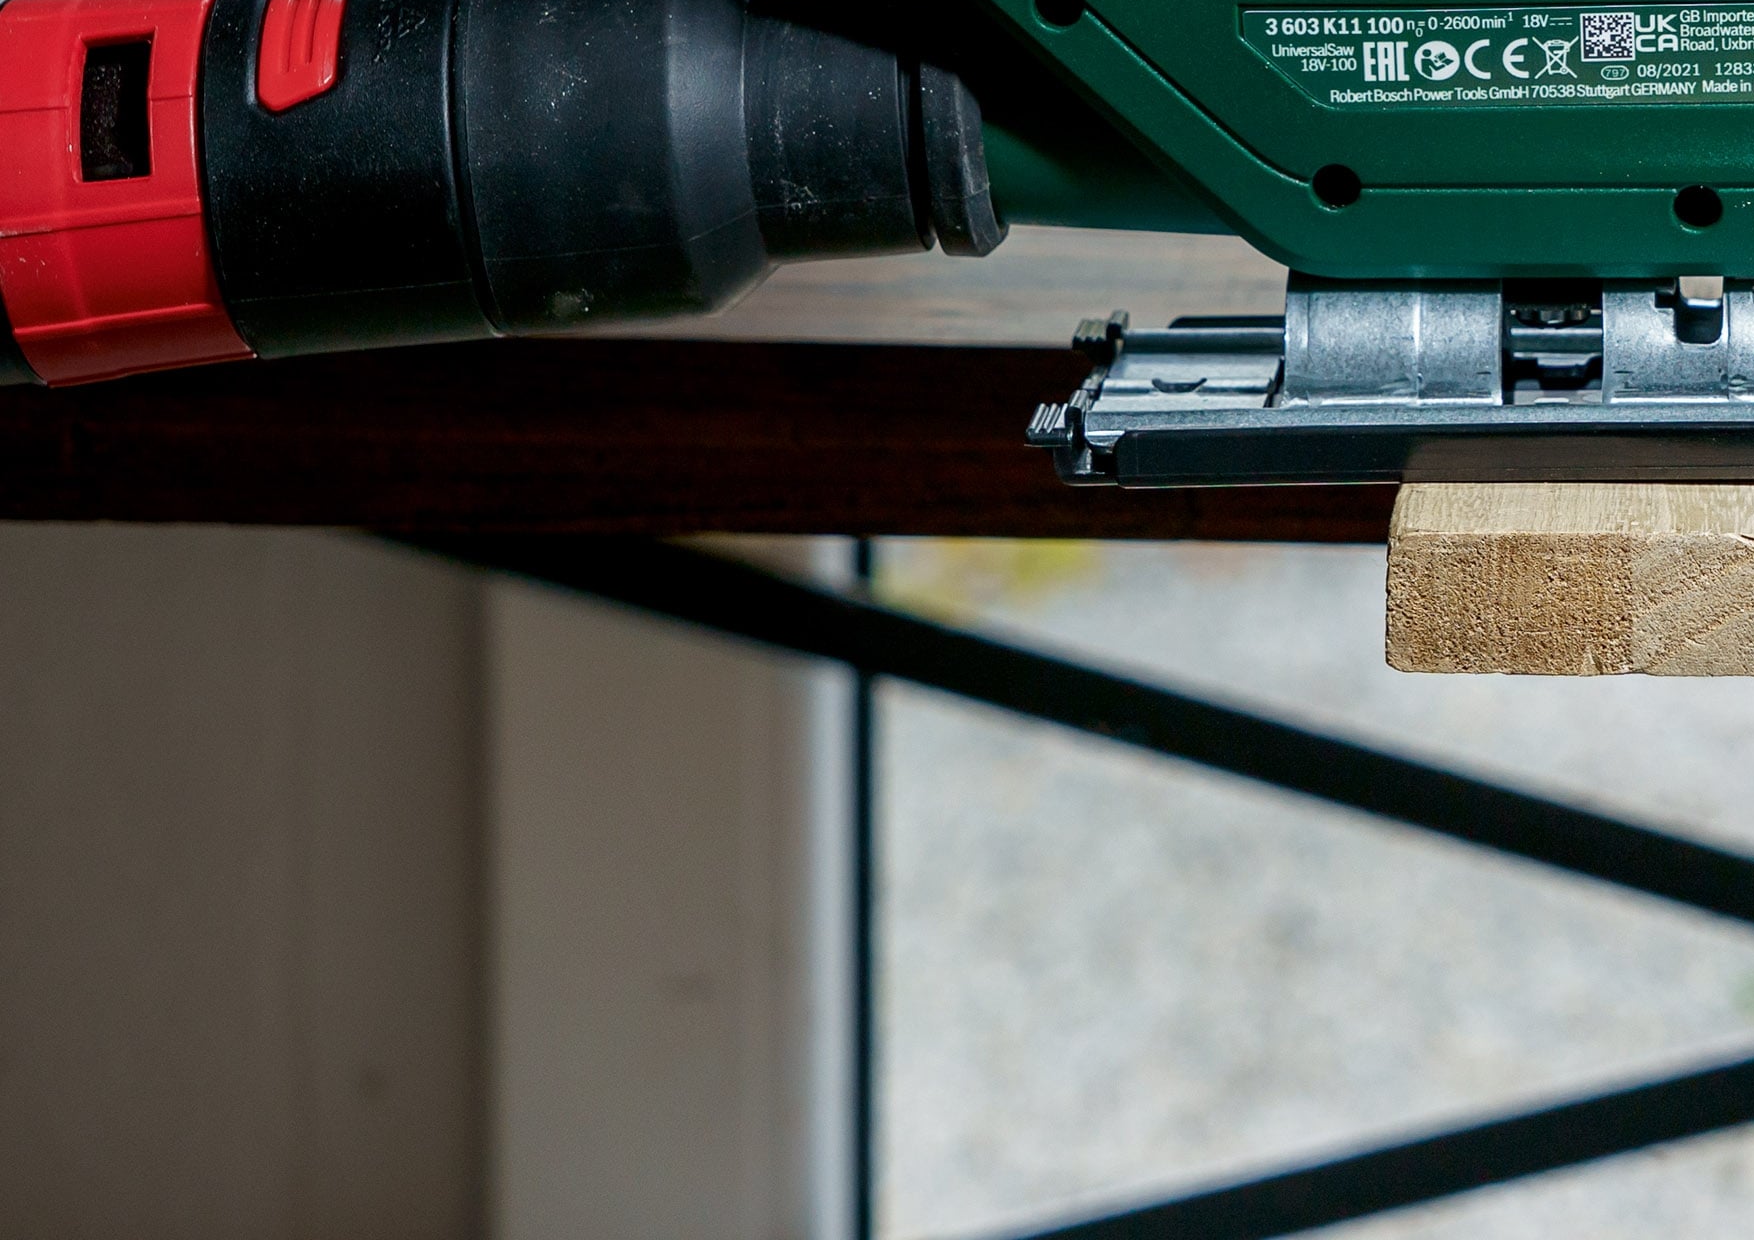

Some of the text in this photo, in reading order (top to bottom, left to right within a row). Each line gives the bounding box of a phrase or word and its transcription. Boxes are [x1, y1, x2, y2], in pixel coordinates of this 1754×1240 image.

[1522, 14, 1549, 29] 18V
[1634, 14, 1678, 33] UK
[1680, 10, 1700, 23] GB
[1265, 17, 1404, 36] 3 603 K11 100
[1272, 43, 1354, 57] UniversalSaw
[1635, 34, 1679, 52] CA
[1680, 38, 1719, 52] Road,
[1301, 58, 1357, 72] 18V-100
[1637, 63, 1700, 79] 08/2021
[1605, 68, 1626, 78] 797
[1330, 89, 1373, 103] Robert
[1374, 88, 1413, 102] Bosch
[1414, 88, 1453, 102] Power
[1454, 86, 1488, 100] Tools
[1489, 86, 1529, 100] GmbH
[1531, 85, 1575, 99] 70538
[1576, 84, 1631, 99] Stuttgart
[1631, 82, 1697, 96] GERMANY
[1702, 79, 1738, 93] Made
[1740, 79, 1752, 92] in
